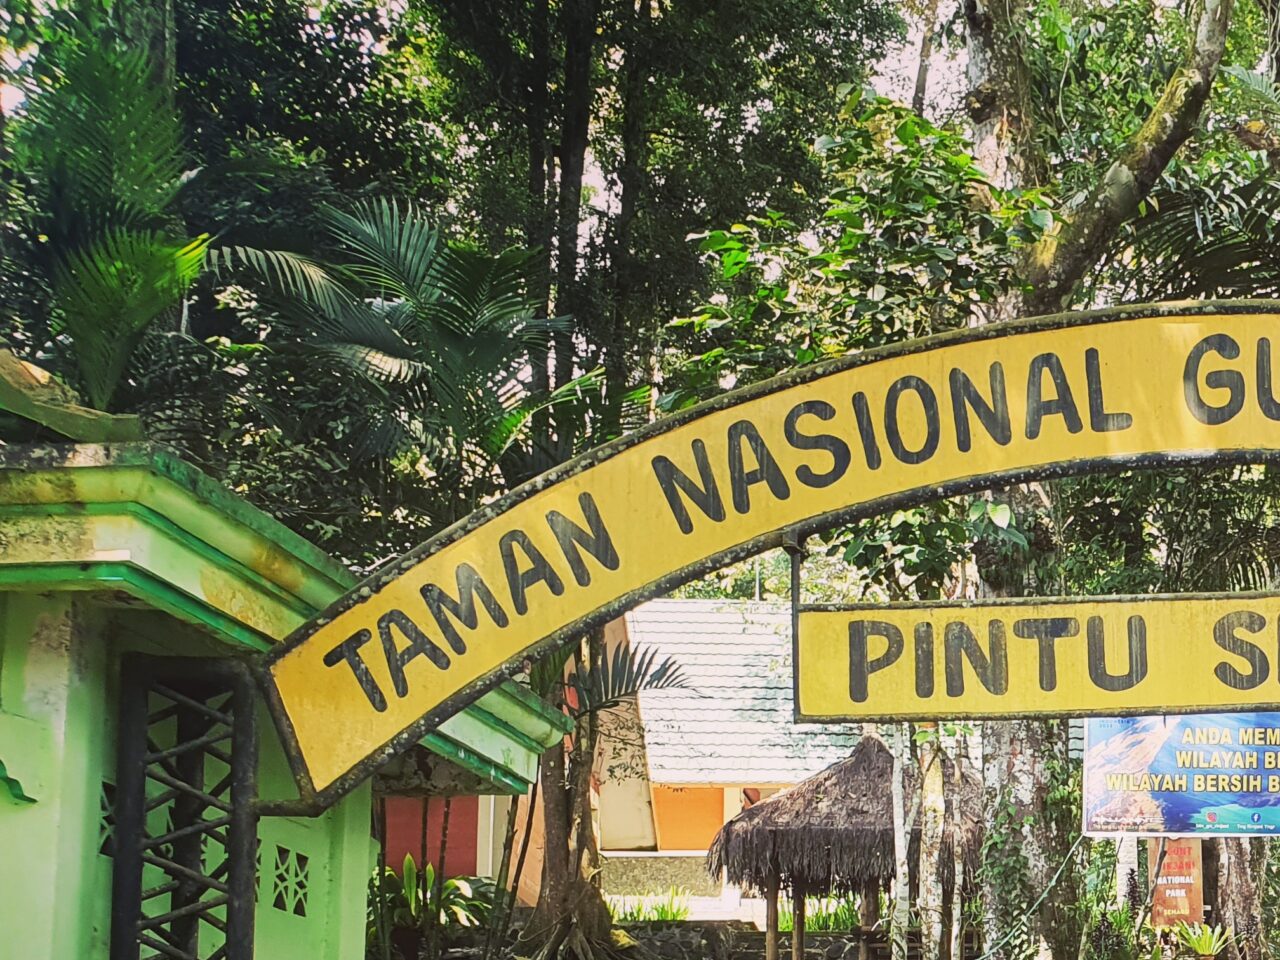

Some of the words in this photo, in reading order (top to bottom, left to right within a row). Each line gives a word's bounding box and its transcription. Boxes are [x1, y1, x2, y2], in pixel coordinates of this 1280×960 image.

[323, 491, 621, 712] TAMAN
[651, 347, 1132, 535] NASIONAL
[848, 614, 1148, 703] PINTU
[1181, 728, 1232, 746] ANDA
[1175, 751, 1258, 769] WILAYAH
[1106, 774, 1187, 792] WILAYAH
[1193, 775, 1262, 792] BERSIH
